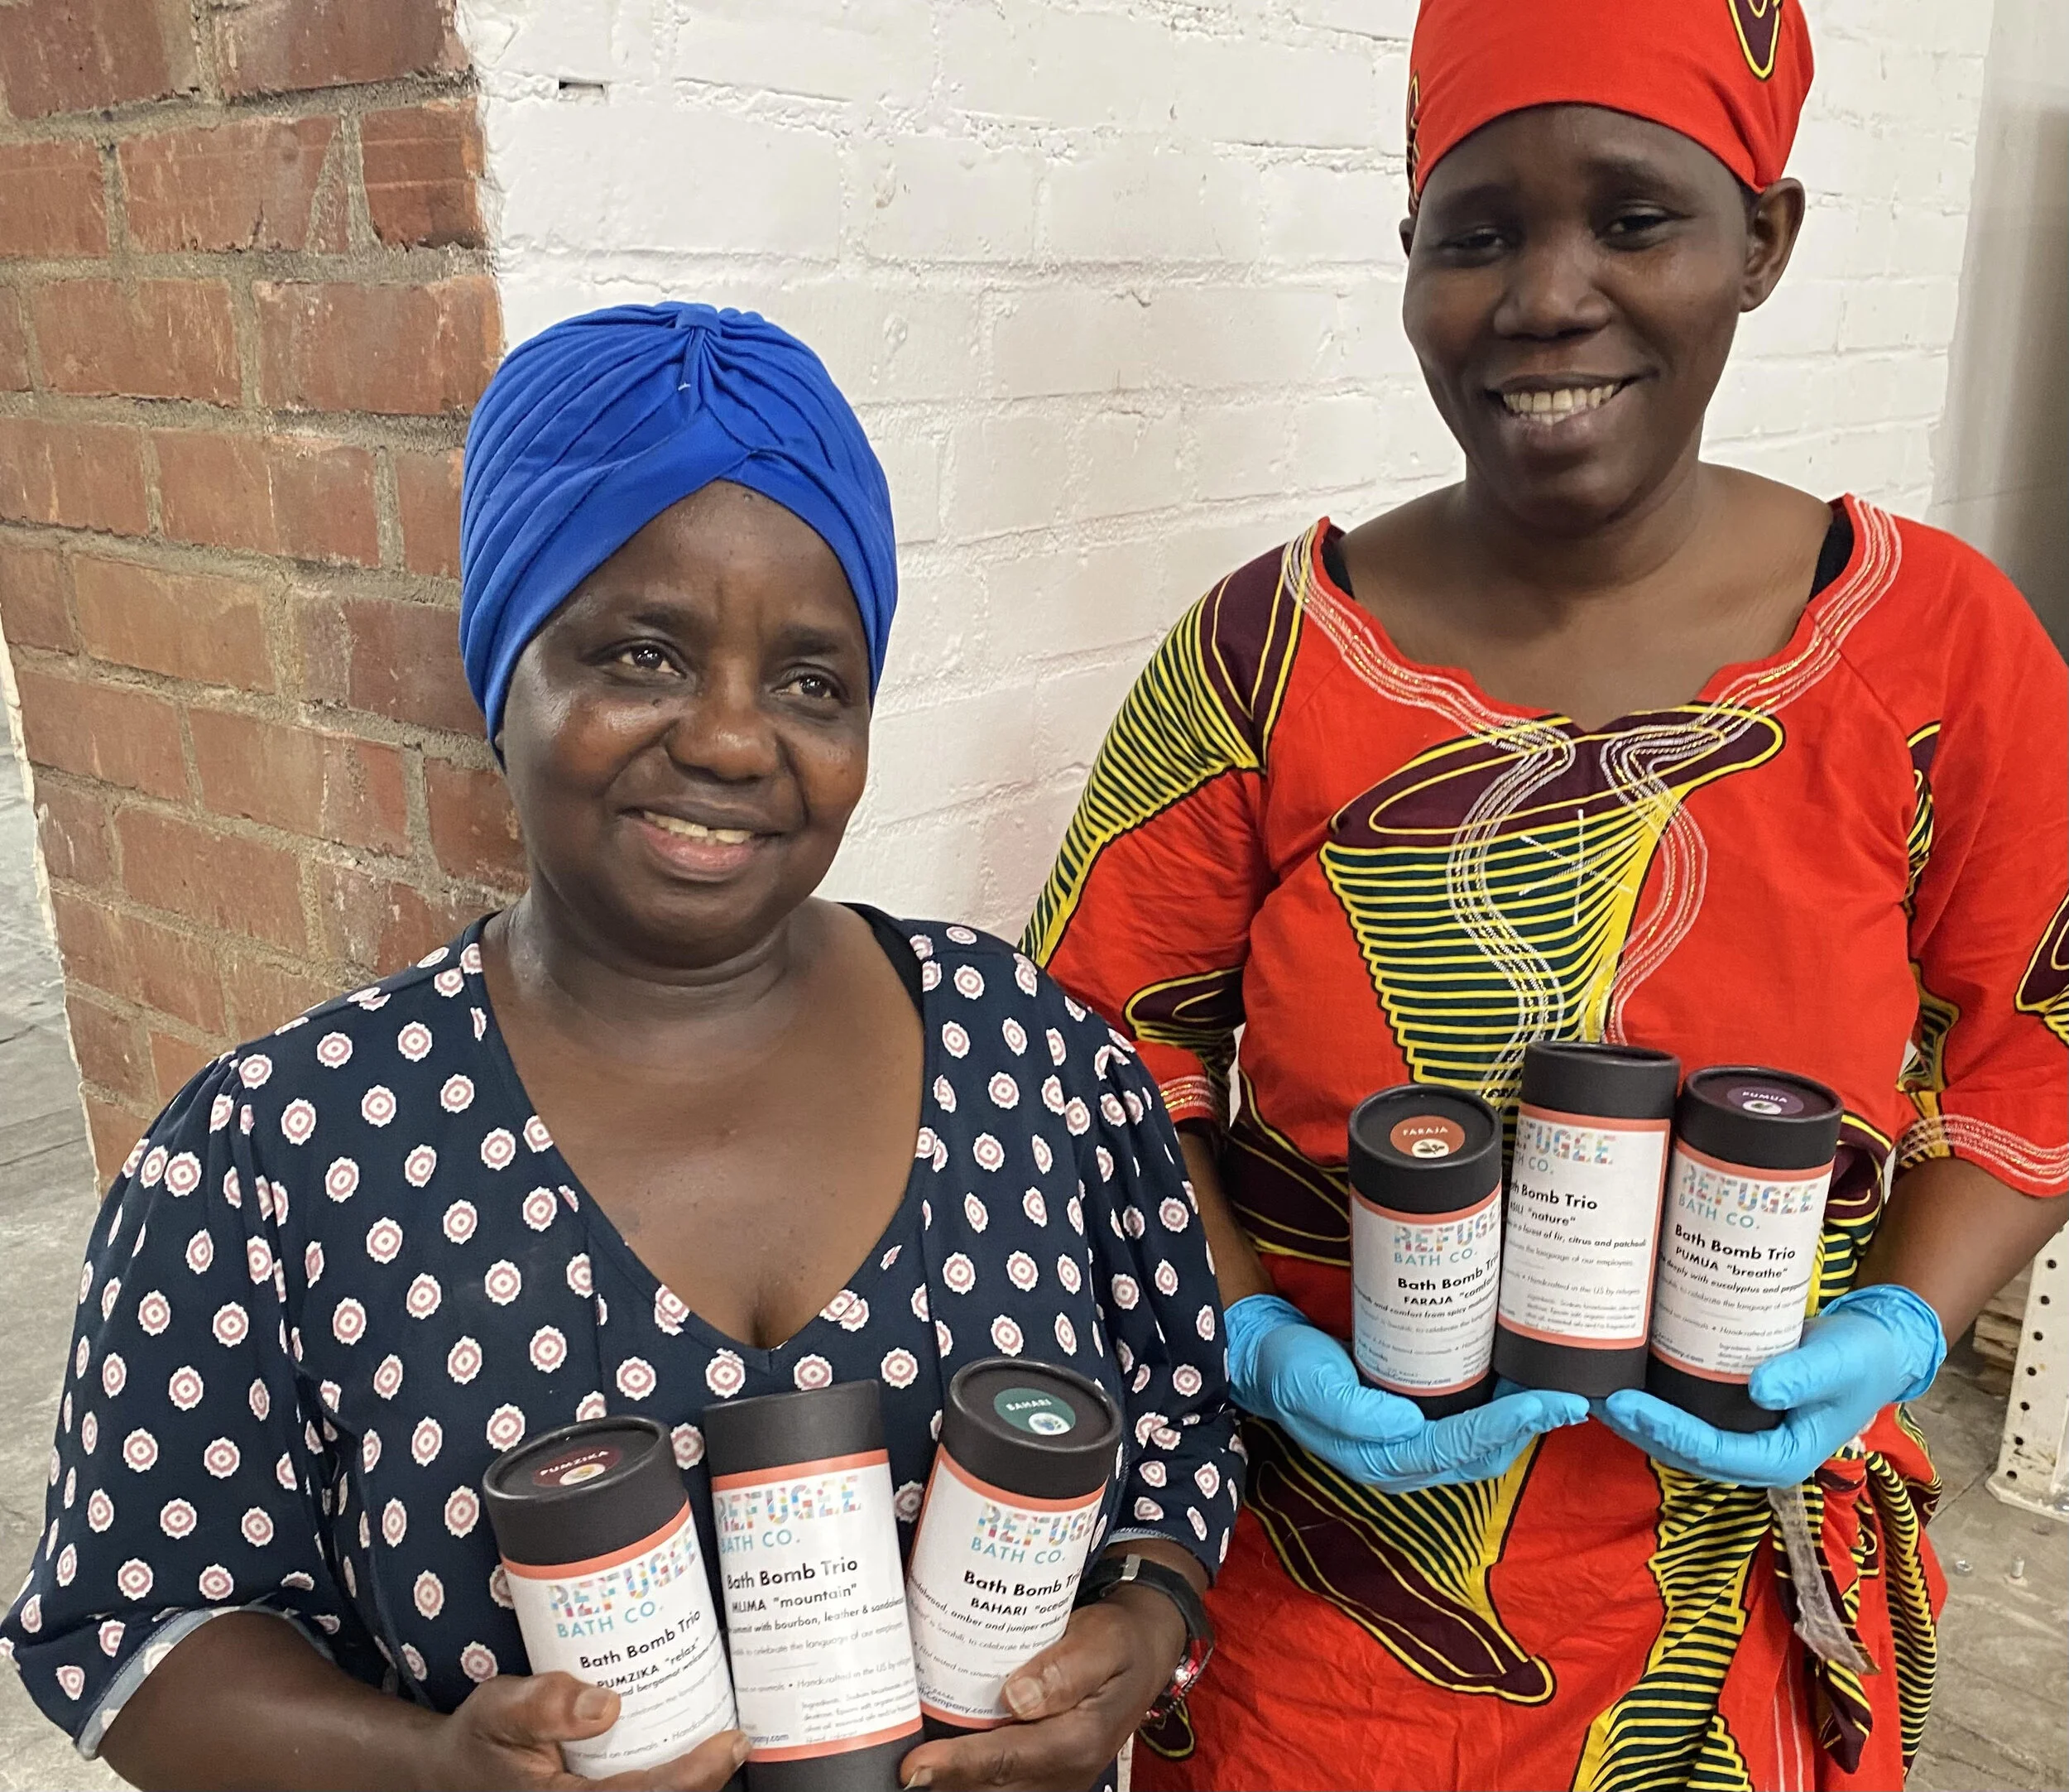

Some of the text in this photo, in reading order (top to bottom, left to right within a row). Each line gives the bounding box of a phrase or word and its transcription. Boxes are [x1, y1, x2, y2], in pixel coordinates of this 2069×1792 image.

[1741, 1090, 1788, 1104] PUMUA
[1402, 1126, 1449, 1136] FARAJA
[1528, 1156, 1554, 1175] CO.
[1521, 1184, 1560, 1205] Bomb
[1564, 1193, 1599, 1210] Trio
[1682, 1161, 1818, 1215] REFUGEE
[1528, 1207, 1577, 1227] "nature"
[1678, 1193, 1761, 1231] BATH CO.
[1543, 1229, 1553, 1239] of
[1568, 1236, 1592, 1247] citrus
[1594, 1239, 1613, 1247] and
[1675, 1223, 1797, 1261] Bath Bomb Trio
[1394, 1247, 1478, 1266] BATH CO.
[1675, 1246, 1720, 1272] PUMUA
[1726, 1263, 1789, 1279] "breathe"
[1397, 1277, 1437, 1291] Bath
[1442, 1266, 1484, 1290] Bomb
[1710, 1279, 1761, 1294] eucalyptus
[1762, 1285, 1780, 1294] and
[1404, 1295, 1454, 1306] FARAJA
[1005, 1398, 1053, 1411] BAHARI
[539, 1450, 610, 1477] PUMZIKA
[716, 1474, 862, 1533] REFUGEE
[720, 1528, 801, 1554] BATH CO.
[971, 1535, 1066, 1564] BATH CO.
[548, 1524, 698, 1619] REFUGEE
[727, 1556, 858, 1590] Bath Bomb Trio
[963, 1569, 1008, 1596] Bath
[1012, 1579, 1063, 1597] Bomb
[773, 1583, 857, 1609] "mountain"
[971, 1597, 1028, 1617] BAHARI
[557, 1600, 665, 1639] BATH CO.
[775, 1615, 821, 1631] bourbon,
[824, 1608, 859, 1622] leather
[862, 1603, 869, 1615] &
[951, 1610, 982, 1627] amber
[984, 1621, 1006, 1632] and
[1006, 1623, 1039, 1634] juniper
[579, 1610, 701, 1669] Bath Bomb Trio
[597, 1664, 660, 1689] PUMZIKA
